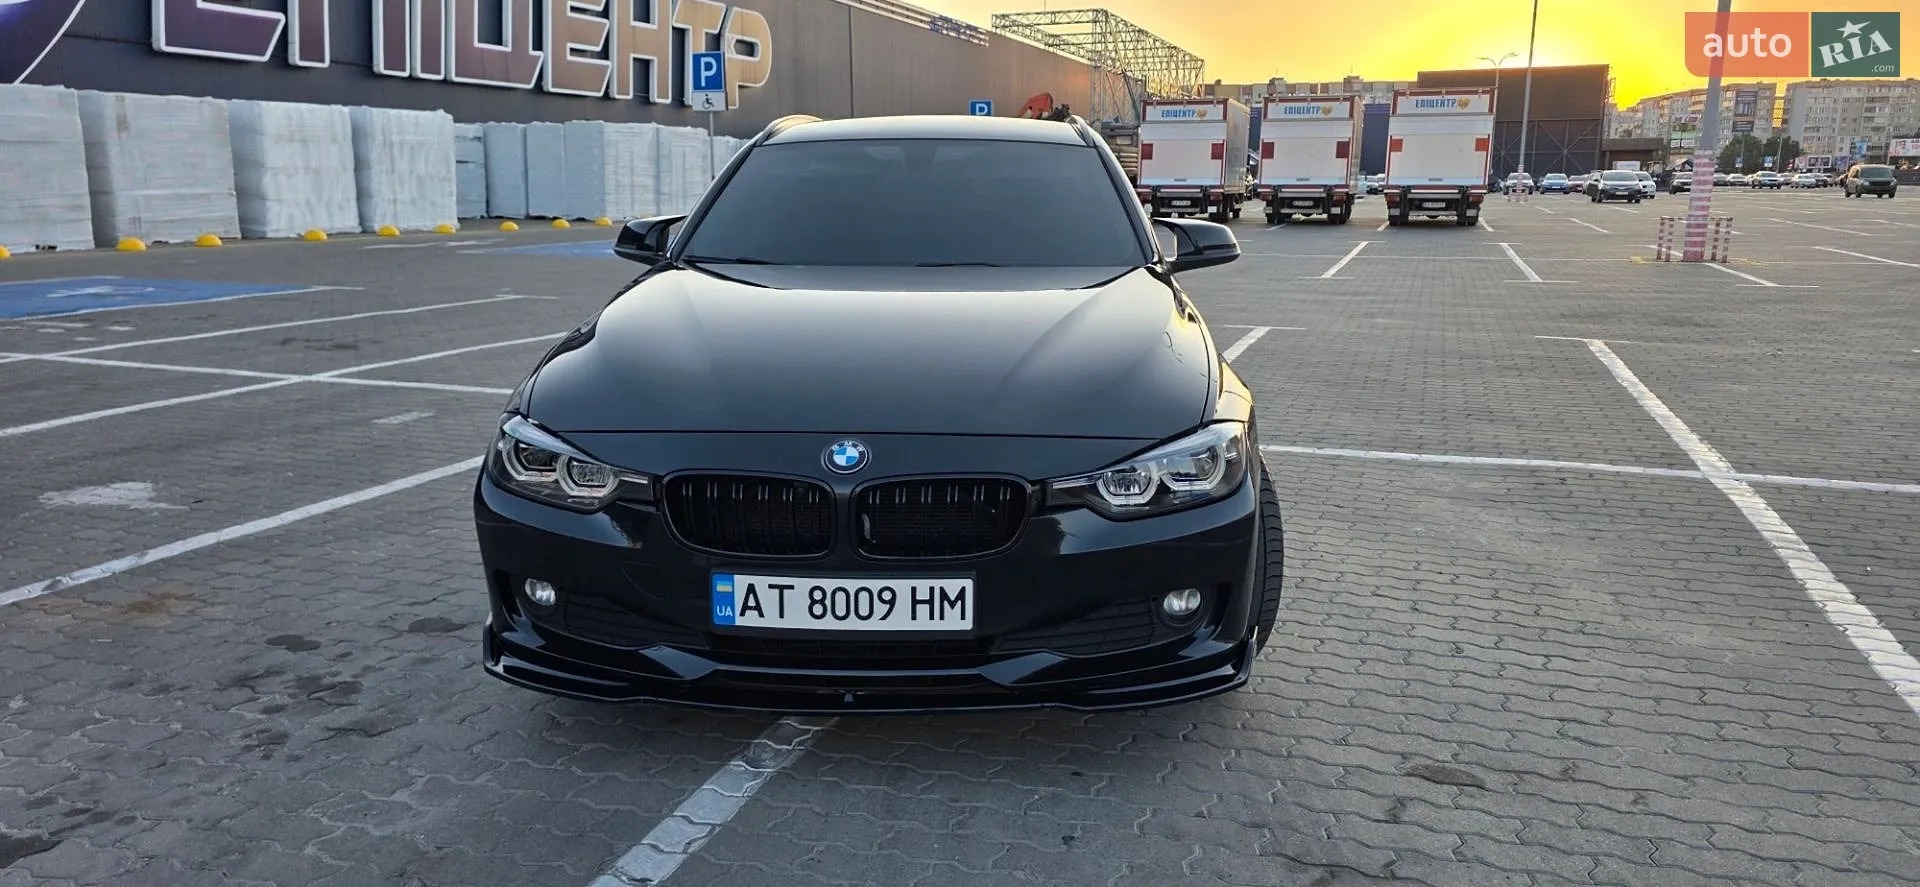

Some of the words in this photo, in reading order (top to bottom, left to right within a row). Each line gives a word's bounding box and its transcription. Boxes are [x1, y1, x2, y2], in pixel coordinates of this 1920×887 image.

[700, 56, 718, 87] P
[716, 605, 733, 617] UA
[739, 583, 795, 619] AT
[807, 585, 897, 621] 8009
[910, 585, 966, 621] HM
